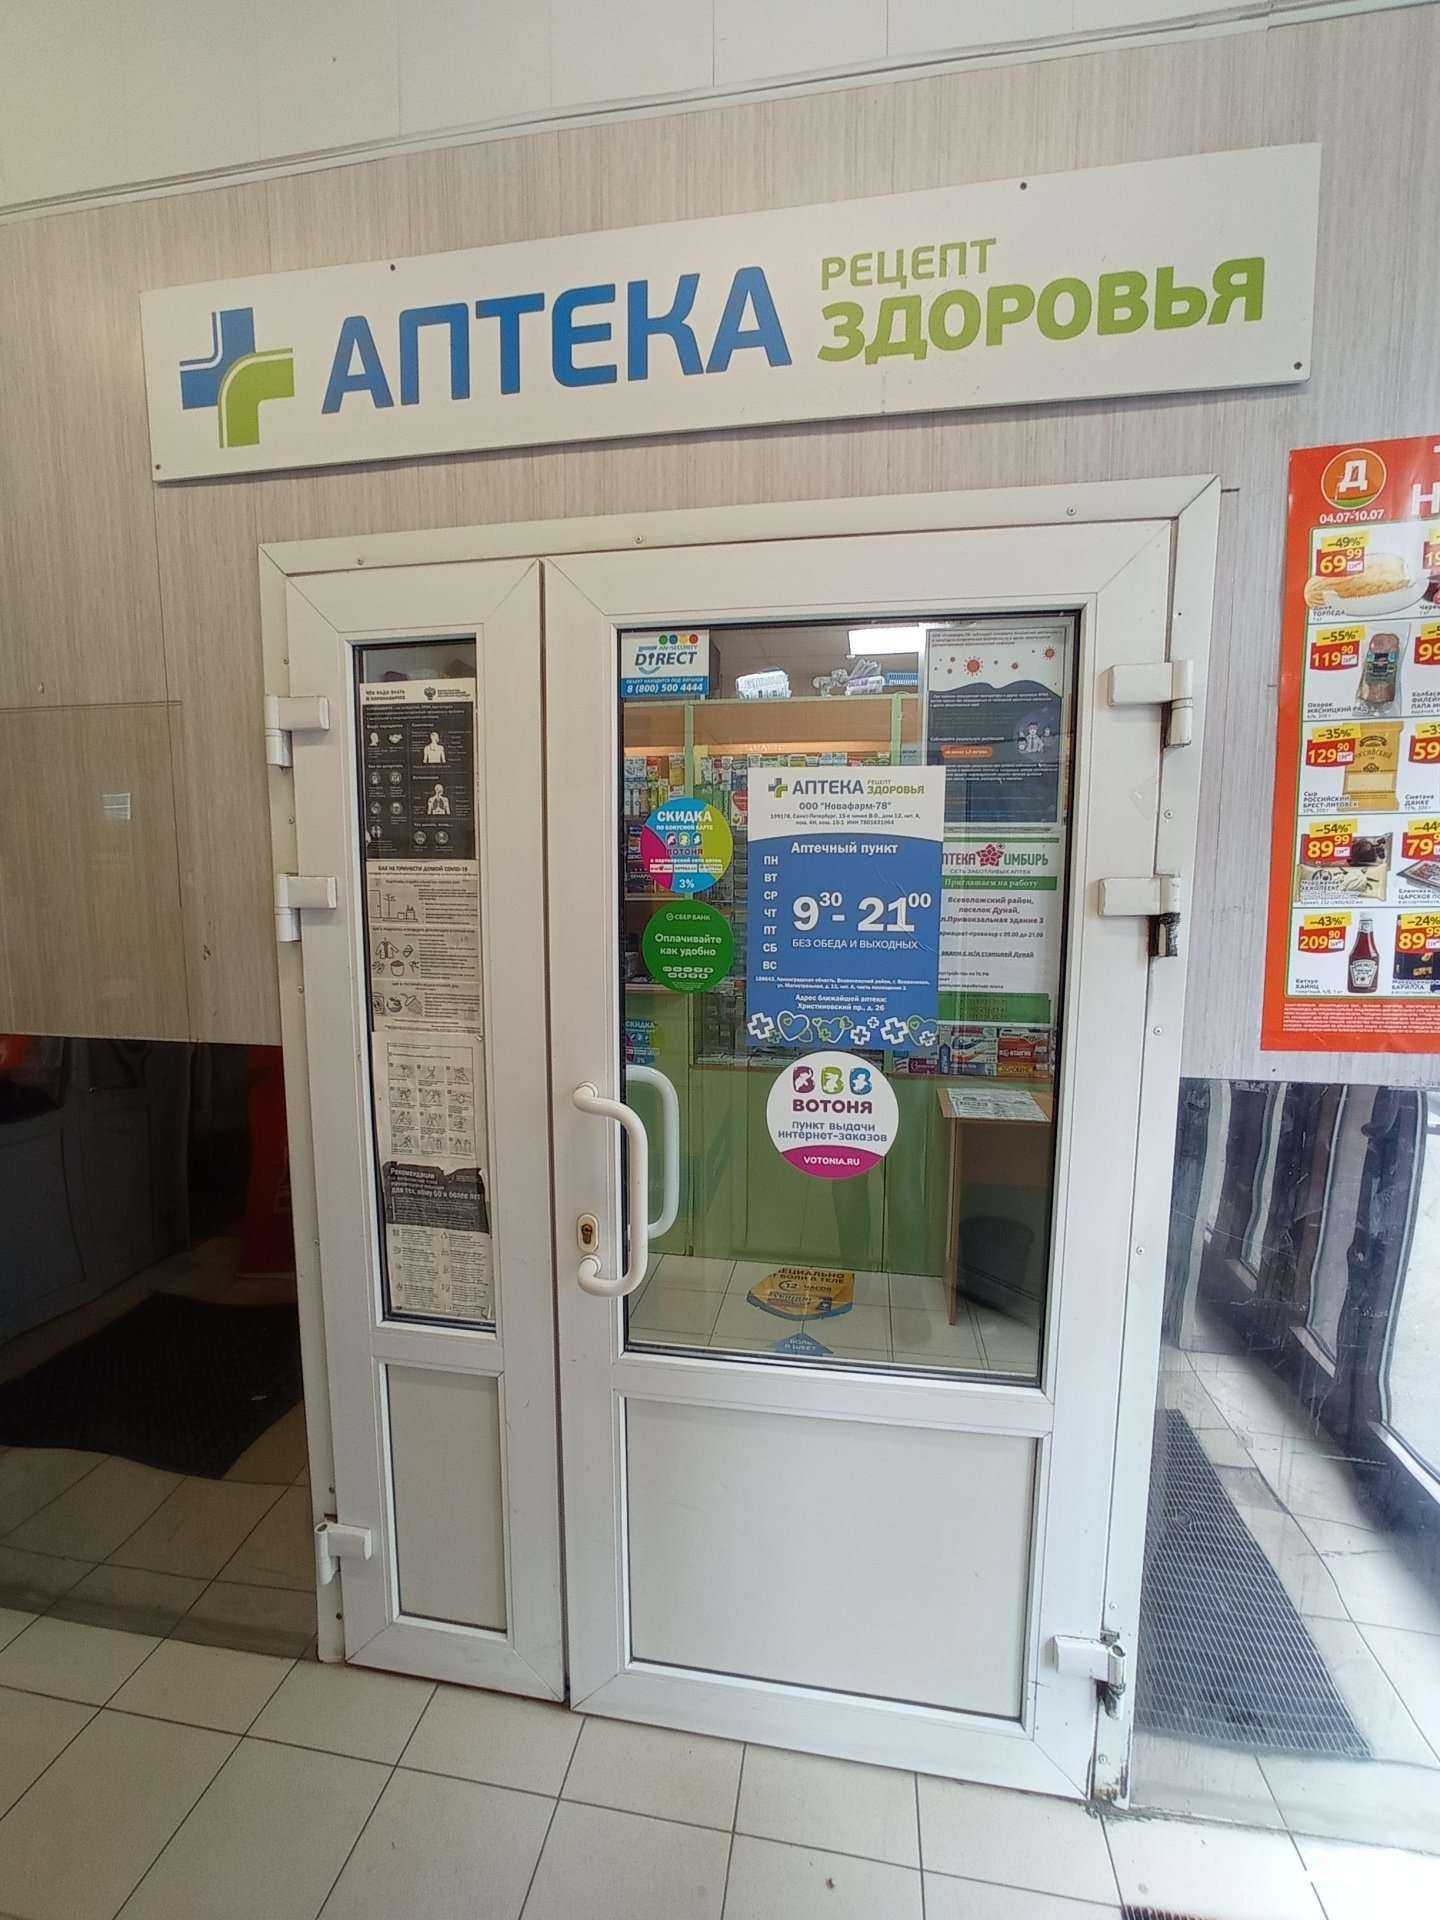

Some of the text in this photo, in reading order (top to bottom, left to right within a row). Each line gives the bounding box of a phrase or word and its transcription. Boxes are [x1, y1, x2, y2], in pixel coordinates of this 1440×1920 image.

[820, 237, 998, 292] РЕЦЕПТ
[321, 256, 1266, 415] АПТЕКА ЗДОРОВЬЯ
[1319, 509, 1385, 525] 04.07-10.07
[1312, 651, 1341, 667] 119
[635, 683, 659, 694] (800)
[661, 683, 678, 693] 500
[680, 682, 703, 692] 4444
[1308, 748, 1337, 764] 129
[792, 777, 925, 796] АПТЕКА ЗДОРОВЬЯ
[799, 801, 892, 812] ООО "Новафарм-78"
[656, 810, 713, 824] СКИДКА
[791, 842, 899, 855] Аптечный пункт
[1307, 840, 1334, 858] 89
[1406, 838, 1433, 857] 79
[763, 855, 779, 865] ПН
[942, 852, 976, 865] ПТЕКА
[679, 878, 695, 890] 3%
[764, 873, 778, 883] ВТ
[763, 890, 778, 901] СР
[763, 908, 777, 918] ЧТ
[858, 896, 915, 932] 21
[941, 916, 1008, 924] л.Привокзальная
[763, 926, 777, 935] ПТ
[655, 933, 722, 944] Оплачивайте
[792, 939, 812, 948] БЕЗ
[813, 940, 848, 949] ОБЕДА
[859, 940, 919, 950] ВЫХОДНЫХ
[1300, 935, 1328, 950] 209
[1399, 932, 1425, 949] 89
[660, 946, 717, 957] как удобно
[762, 943, 778, 953] СБ
[762, 961, 777, 970] ВС
[795, 993, 817, 1002] Адрес
[818, 994, 860, 1003] ближайшей
[792, 1099, 872, 1114] ВОТОНЯ
[792, 1121, 876, 1132] пункт выдачи
[778, 1131, 888, 1142] интернет-заказов
[804, 1156, 860, 1166] VOTONIA.RU
[778, 1267, 845, 1279] ЕЦИАЛЬНО
